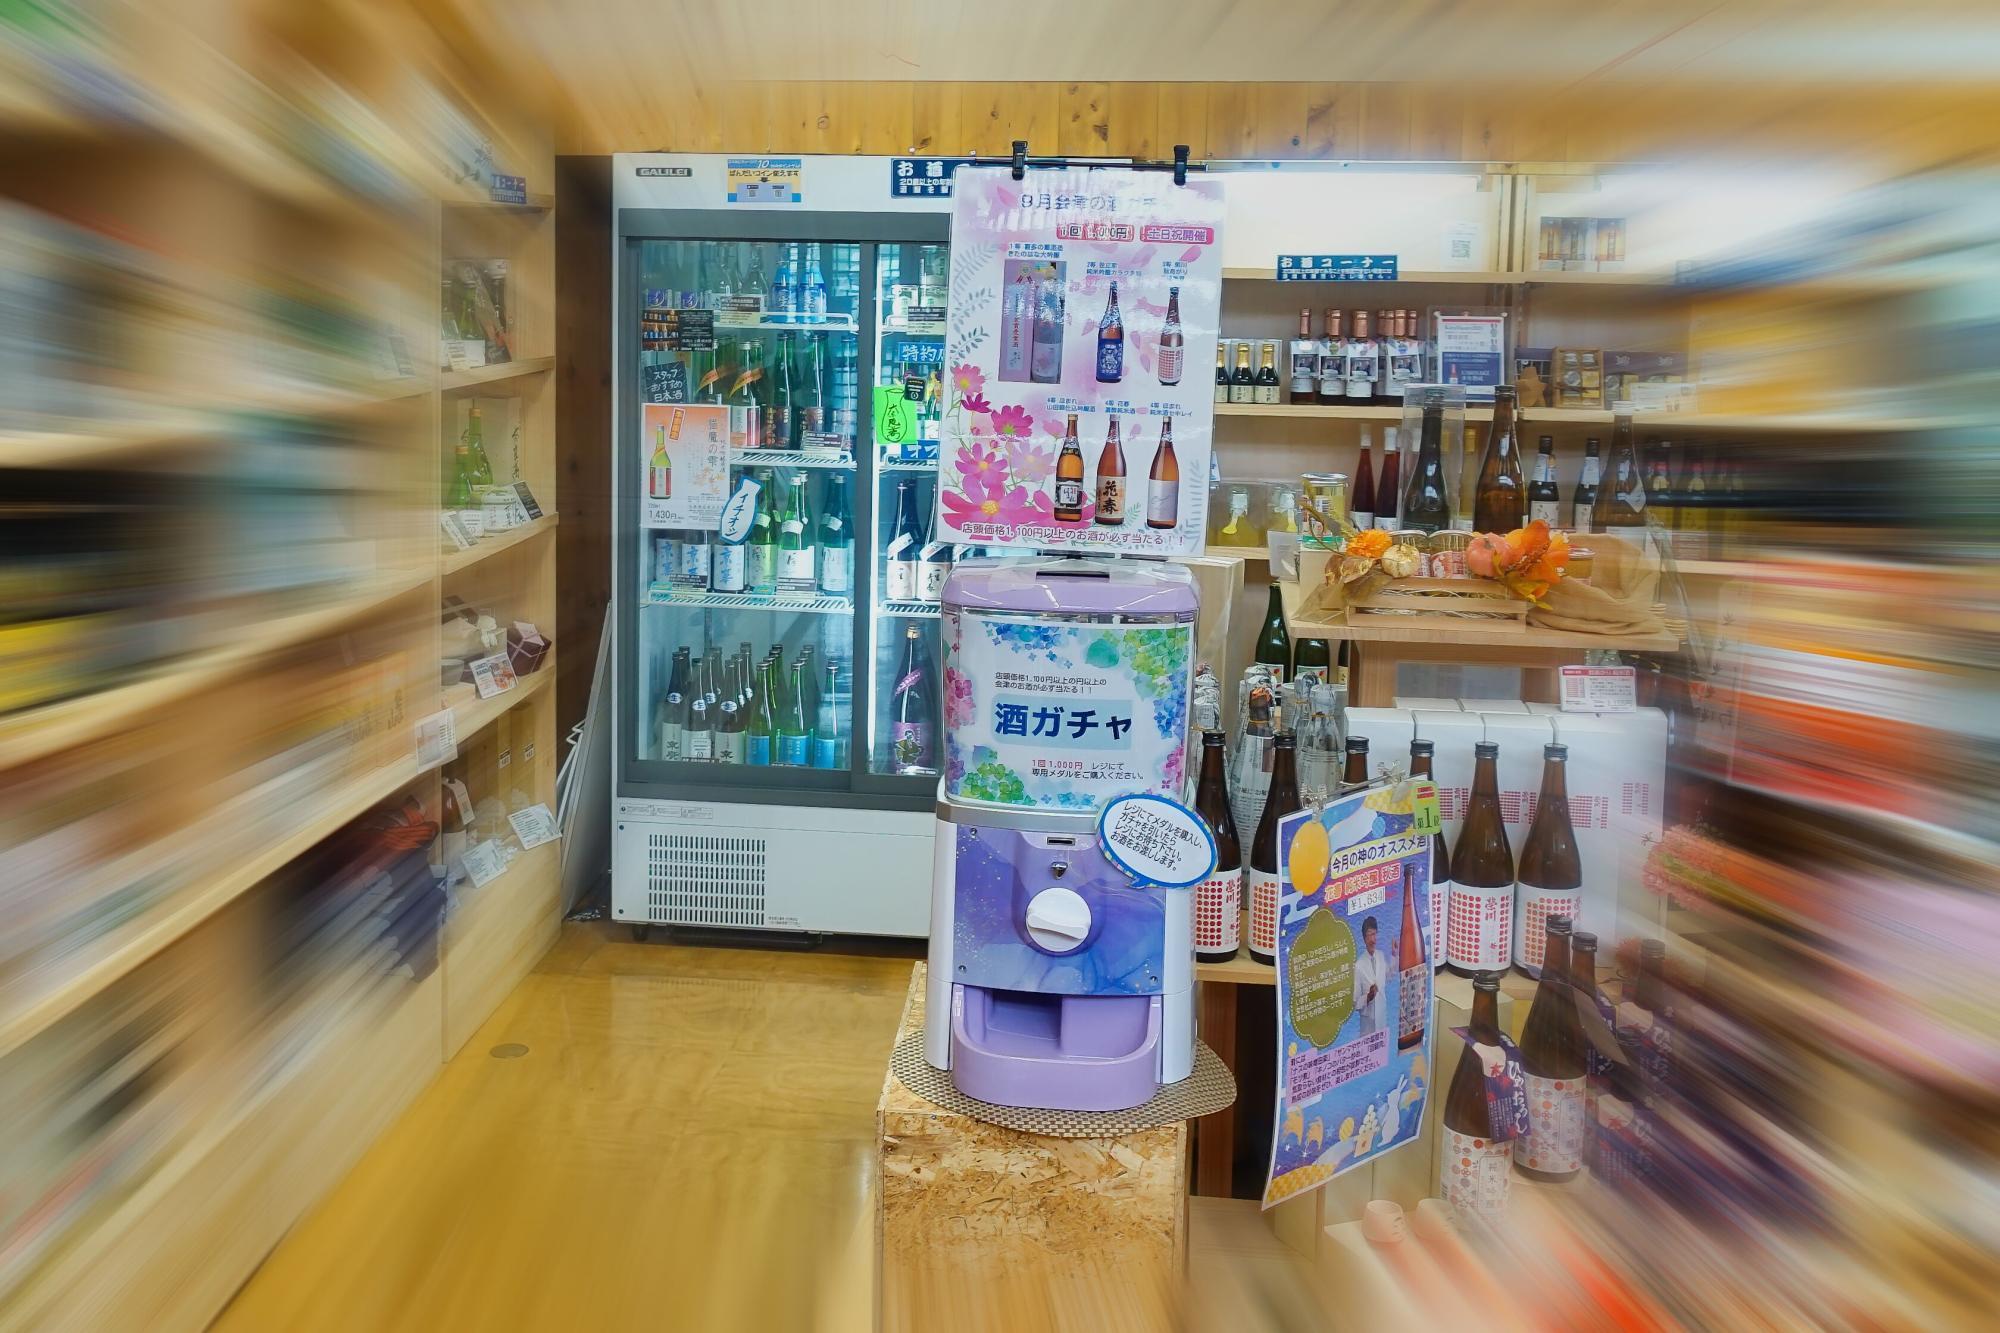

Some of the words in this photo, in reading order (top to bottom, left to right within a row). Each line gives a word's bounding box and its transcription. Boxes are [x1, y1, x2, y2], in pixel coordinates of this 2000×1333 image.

[639, 168, 688, 176] GALILEI
[1148, 228, 1207, 242] 土日祝開催
[651, 379, 683, 392] おすすめ
[653, 368, 678, 380] スタッフ
[654, 389, 683, 402] 日本酒
[1102, 480, 1119, 514] 花春
[725, 493, 749, 537] イチオシ
[994, 702, 1133, 740] 酒ガチャ
[1031, 768, 1145, 780] 専用メダルをご購入ください。
[1032, 759, 1047, 768] 1回
[1048, 760, 1083, 770] 1,000円
[1091, 761, 1125, 771] レジにて
[1115, 819, 1182, 862] レジにお待ち下さい。
[1119, 811, 1177, 846] ガチャを引いたら
[1124, 801, 1203, 848] レジにてメダルを購入し、
[1110, 831, 1177, 871] お酒をお渡しします。
[1332, 837, 1427, 873] 今月の神のオススメ酒
